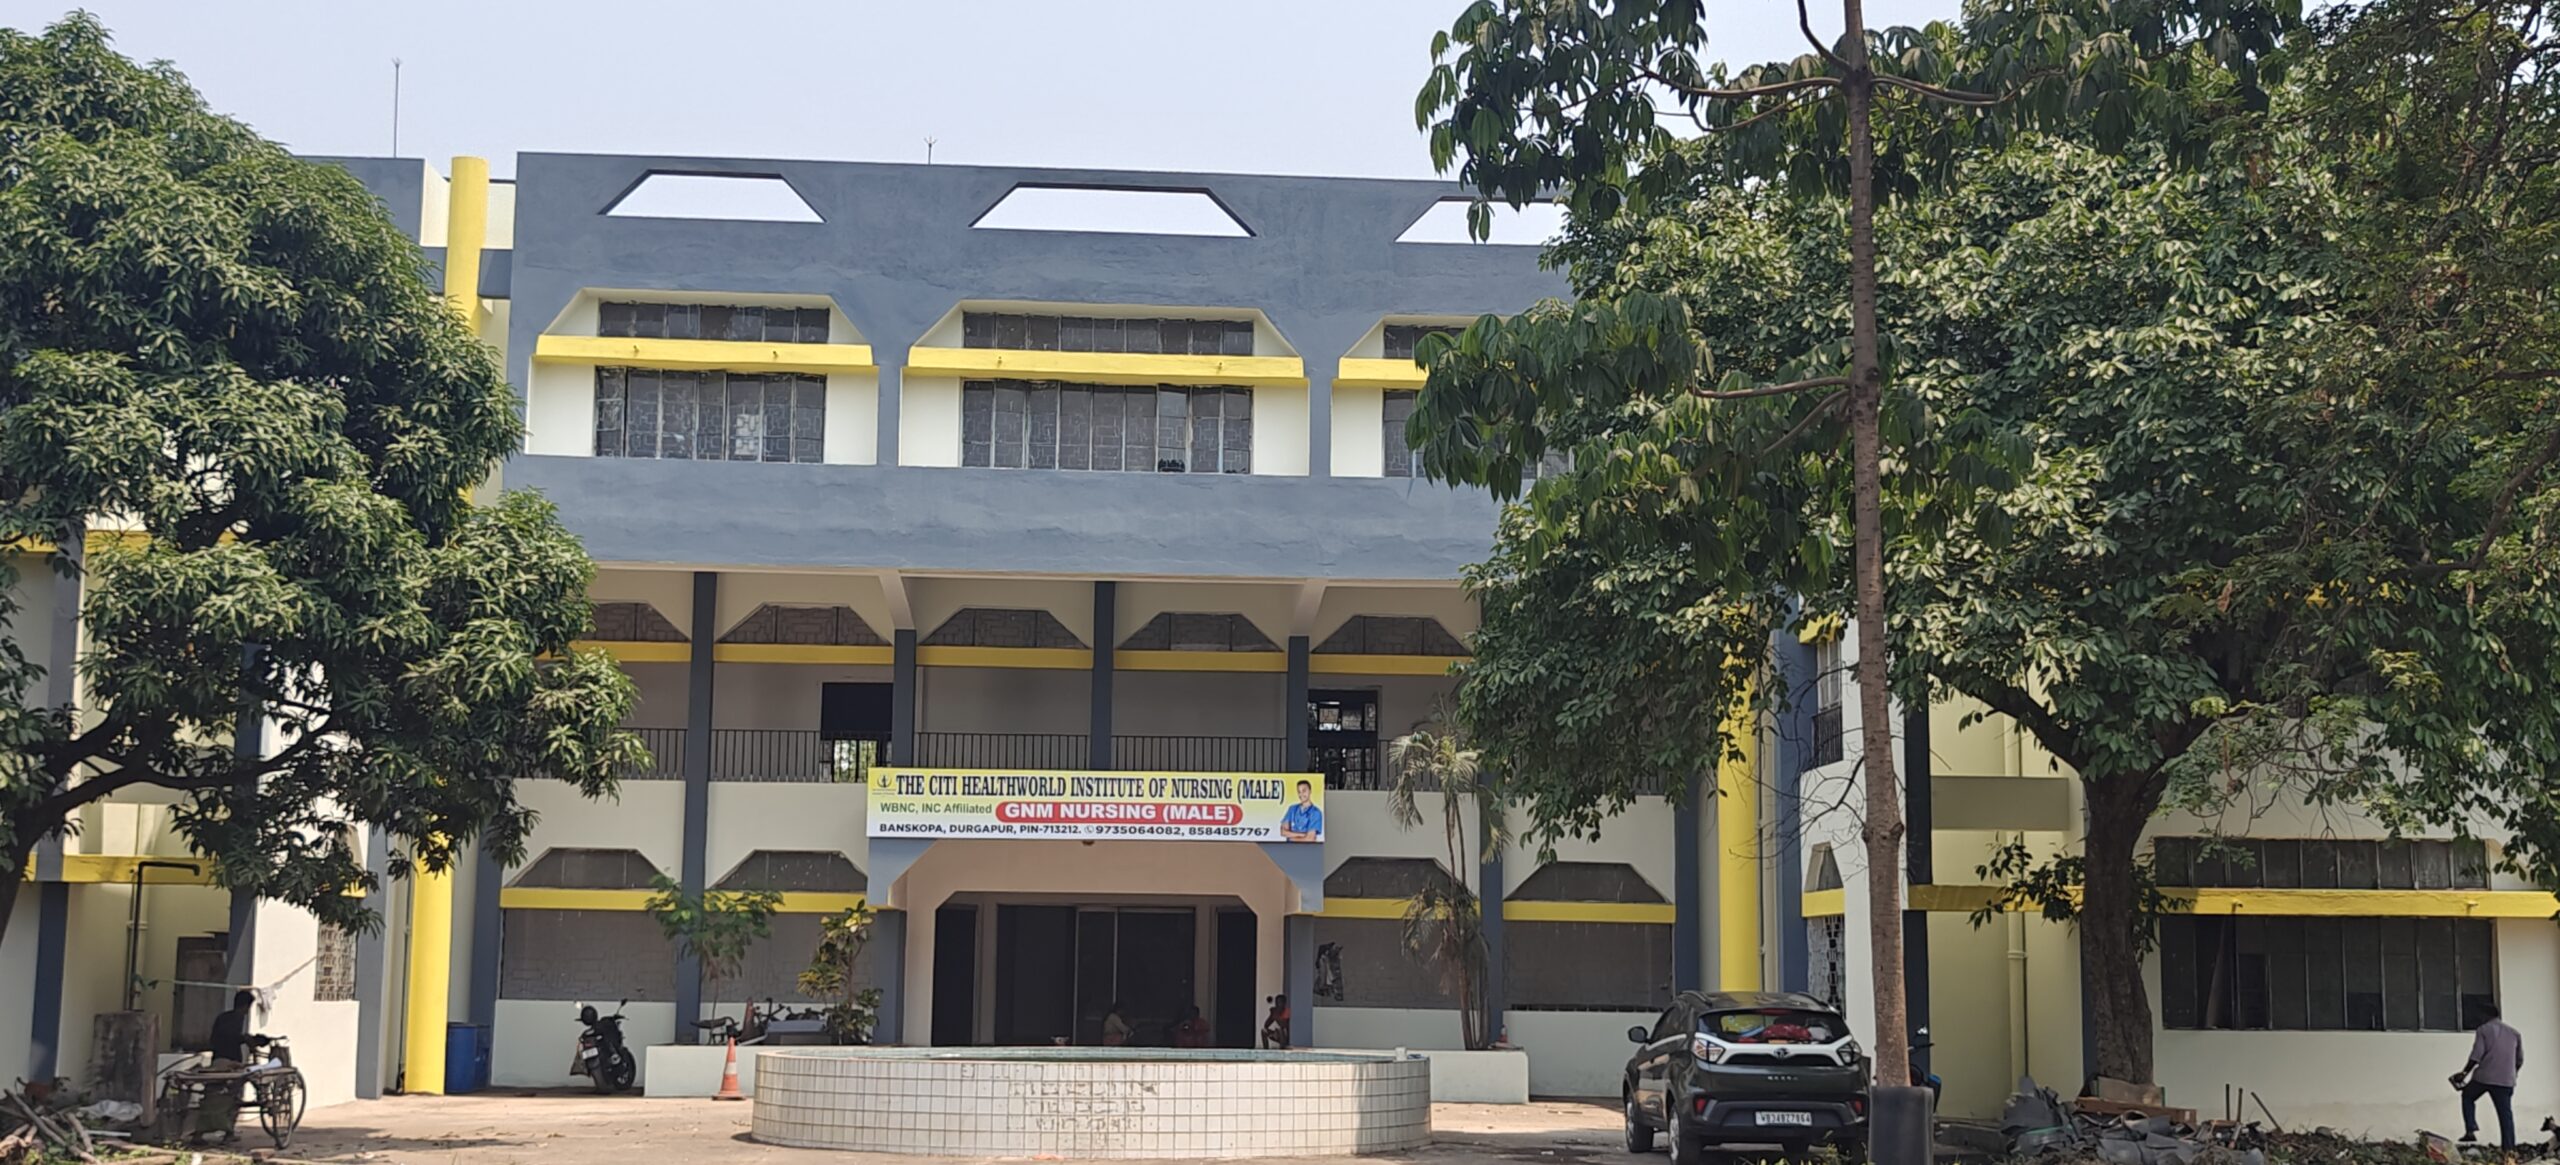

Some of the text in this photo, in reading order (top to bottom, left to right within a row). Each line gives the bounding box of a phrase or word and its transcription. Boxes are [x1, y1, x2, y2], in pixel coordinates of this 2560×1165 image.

[896, 775, 1285, 804] THE CITI HEALTHWORLD INSTITUTE OF NURSING (MALE)
[880, 803, 992, 814] WBNC, INC Affiliated
[1005, 803, 1234, 823] GNM NURSING (MALE)
[880, 823, 1270, 837] BANSKOPA, DURGAPUR, PIN-713212. 9735064082, 8584857767
